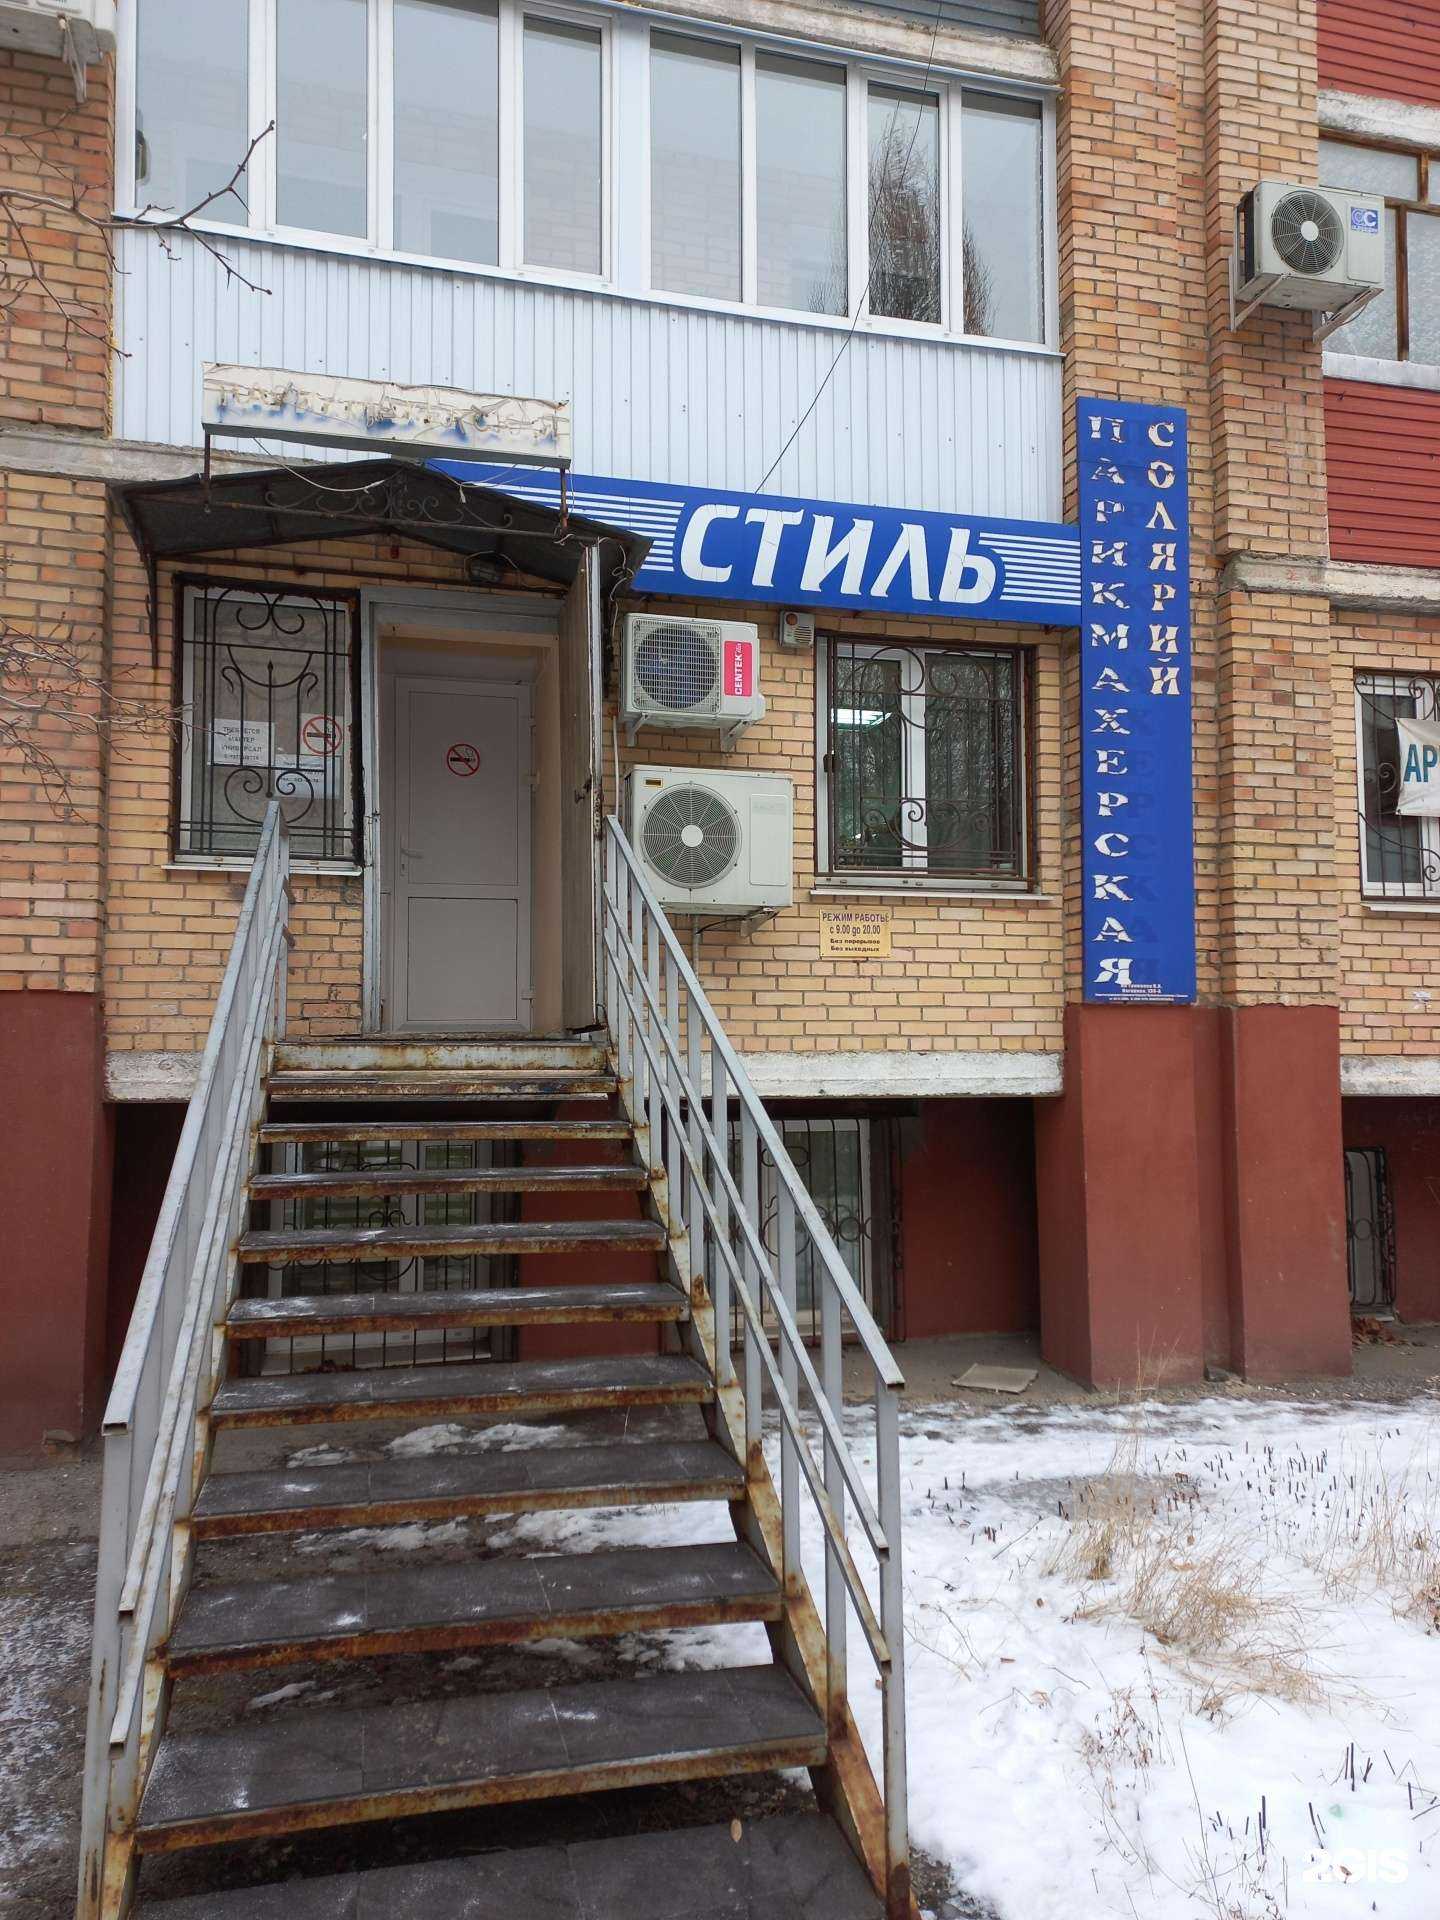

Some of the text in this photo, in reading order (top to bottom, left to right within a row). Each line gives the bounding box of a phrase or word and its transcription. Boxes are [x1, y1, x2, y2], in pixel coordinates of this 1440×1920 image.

[679, 503, 1001, 604] СТИЛЬ
[1145, 421, 1180, 696] СОЛЯРИЙ
[734, 655, 743, 695] CENTEK
[1087, 415, 1134, 985] ПАРИКМАХЕРСКАЯ
[1403, 743, 1440, 783] АР
[822, 912, 853, 922] РЕЖИМ
[836, 924, 851, 935] 9.00
[863, 924, 881, 935] 20.00
